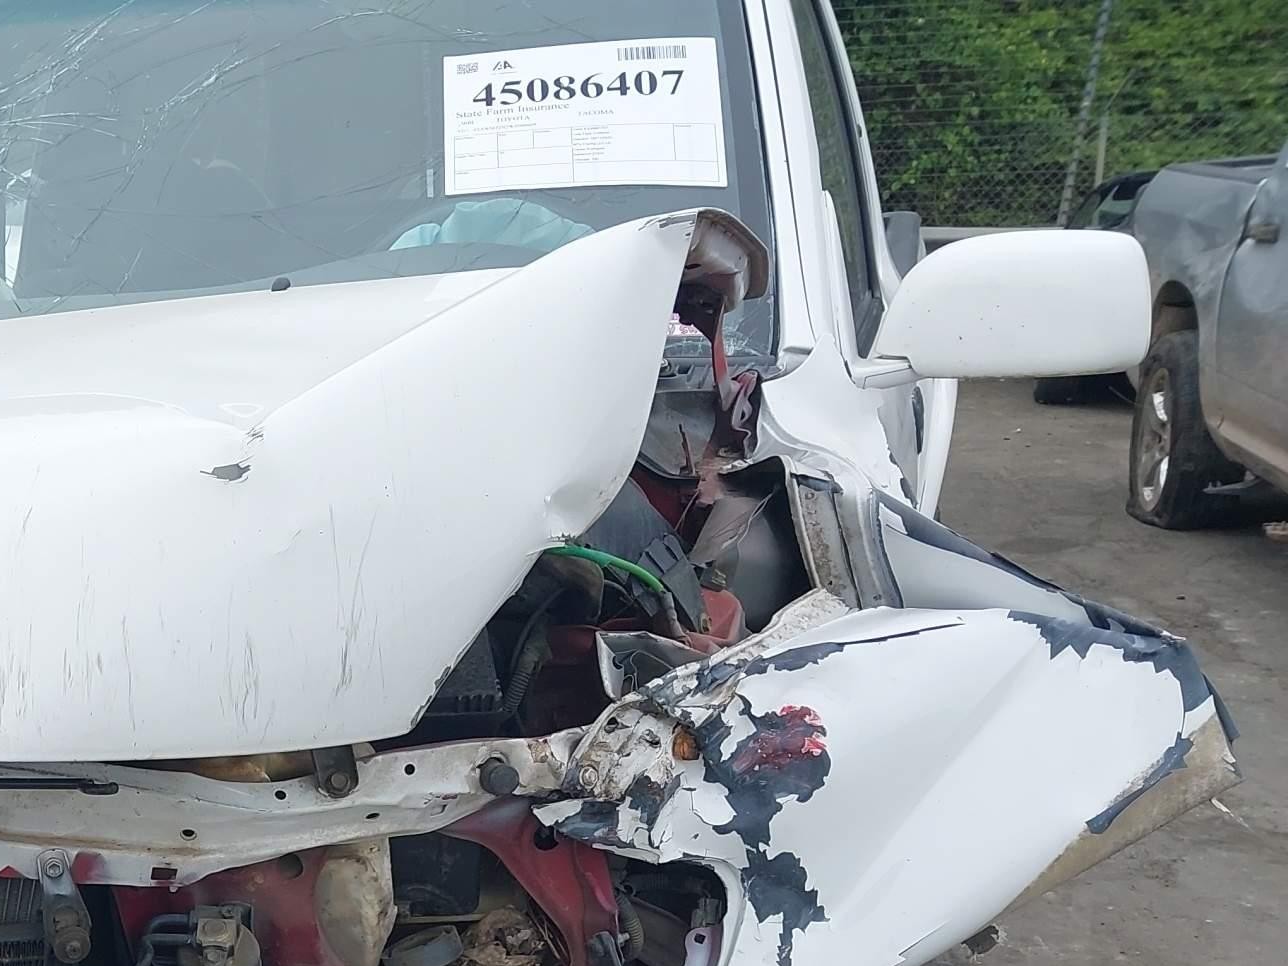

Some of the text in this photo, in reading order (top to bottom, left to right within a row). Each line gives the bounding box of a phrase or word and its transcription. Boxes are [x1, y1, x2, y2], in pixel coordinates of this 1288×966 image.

[473, 70, 684, 106] 45086407
[456, 103, 570, 119] State Farm Insurance
